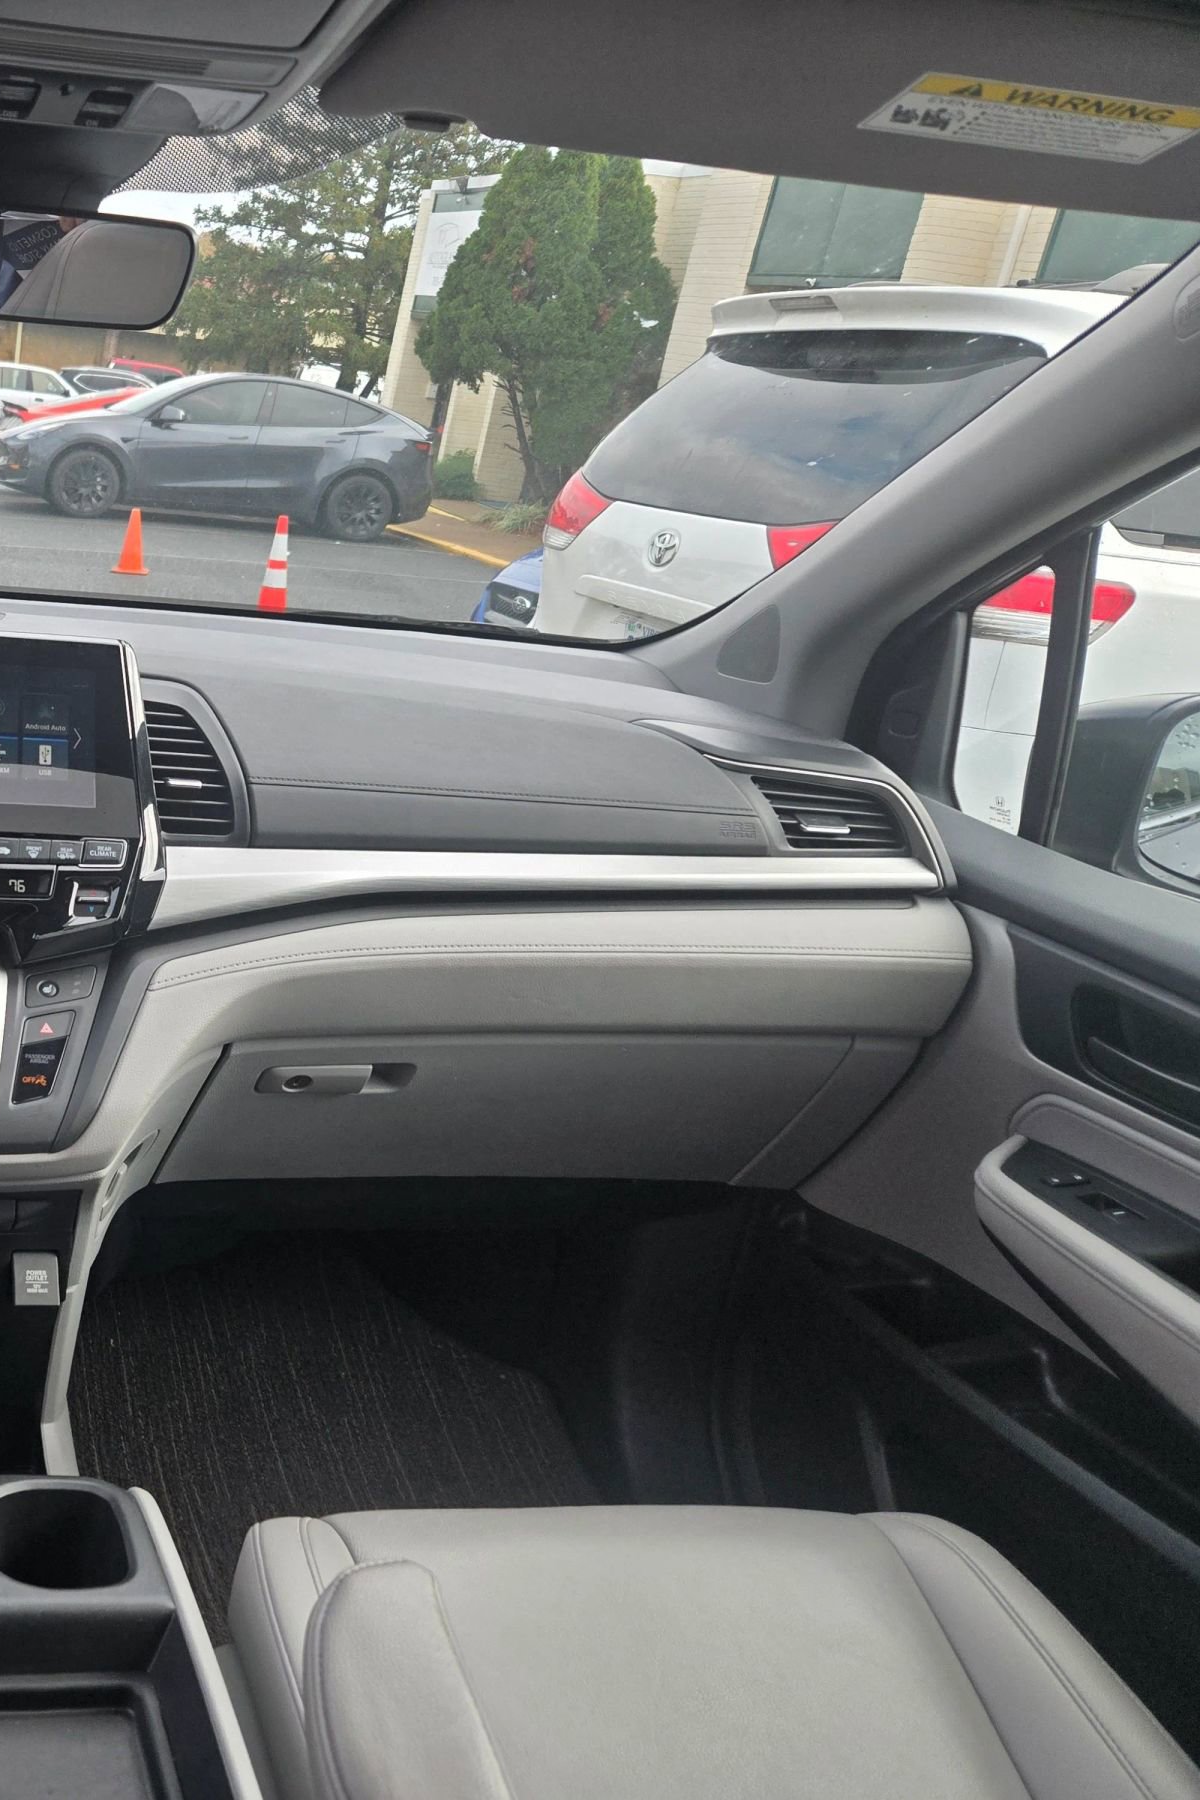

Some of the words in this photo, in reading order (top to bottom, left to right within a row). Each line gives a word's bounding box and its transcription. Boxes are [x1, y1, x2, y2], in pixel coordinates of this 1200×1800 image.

[1006, 88, 1175, 123] WARNING
[25, 723, 50, 731] Android
[89, 850, 117, 858] CLIMATE
[9, 879, 26, 893] 76
[22, 1076, 36, 1084] OFF
